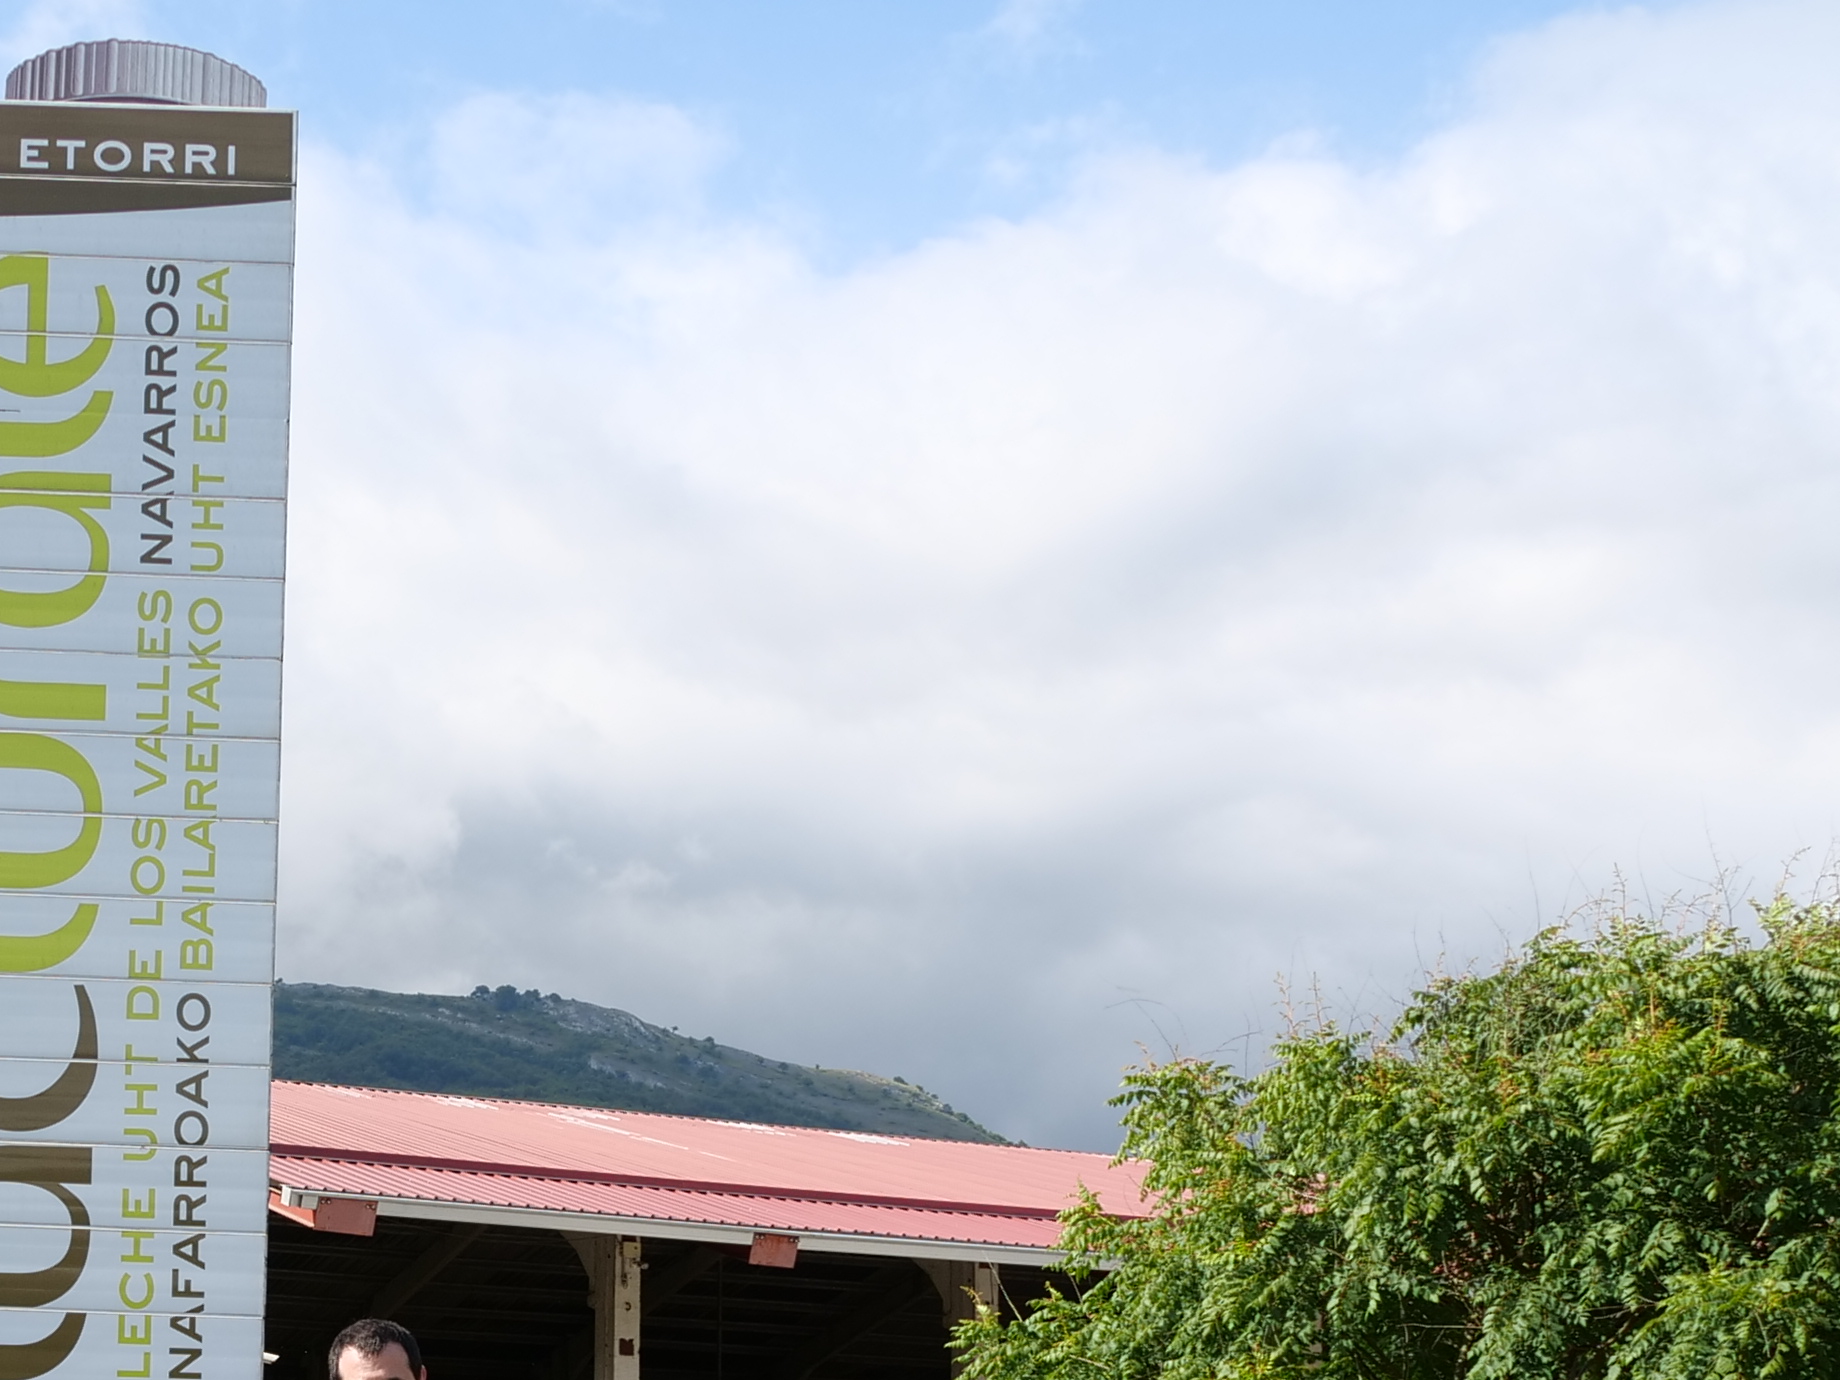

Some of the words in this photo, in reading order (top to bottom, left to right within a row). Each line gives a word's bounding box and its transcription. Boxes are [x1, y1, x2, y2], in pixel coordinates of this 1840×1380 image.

[18, 137, 238, 176] ETORRI
[139, 263, 182, 566] NAVARROS
[192, 266, 231, 444] ESNEA
[189, 463, 225, 572] UHT
[133, 588, 173, 797] VALLES
[129, 818, 168, 926] LOS
[179, 597, 224, 971] BAILARETAKO
[126, 949, 161, 1021] DE
[122, 1043, 159, 1162] UHT
[168, 992, 212, 1380] NAFARROAKO
[116, 1187, 156, 1379] LECHE
